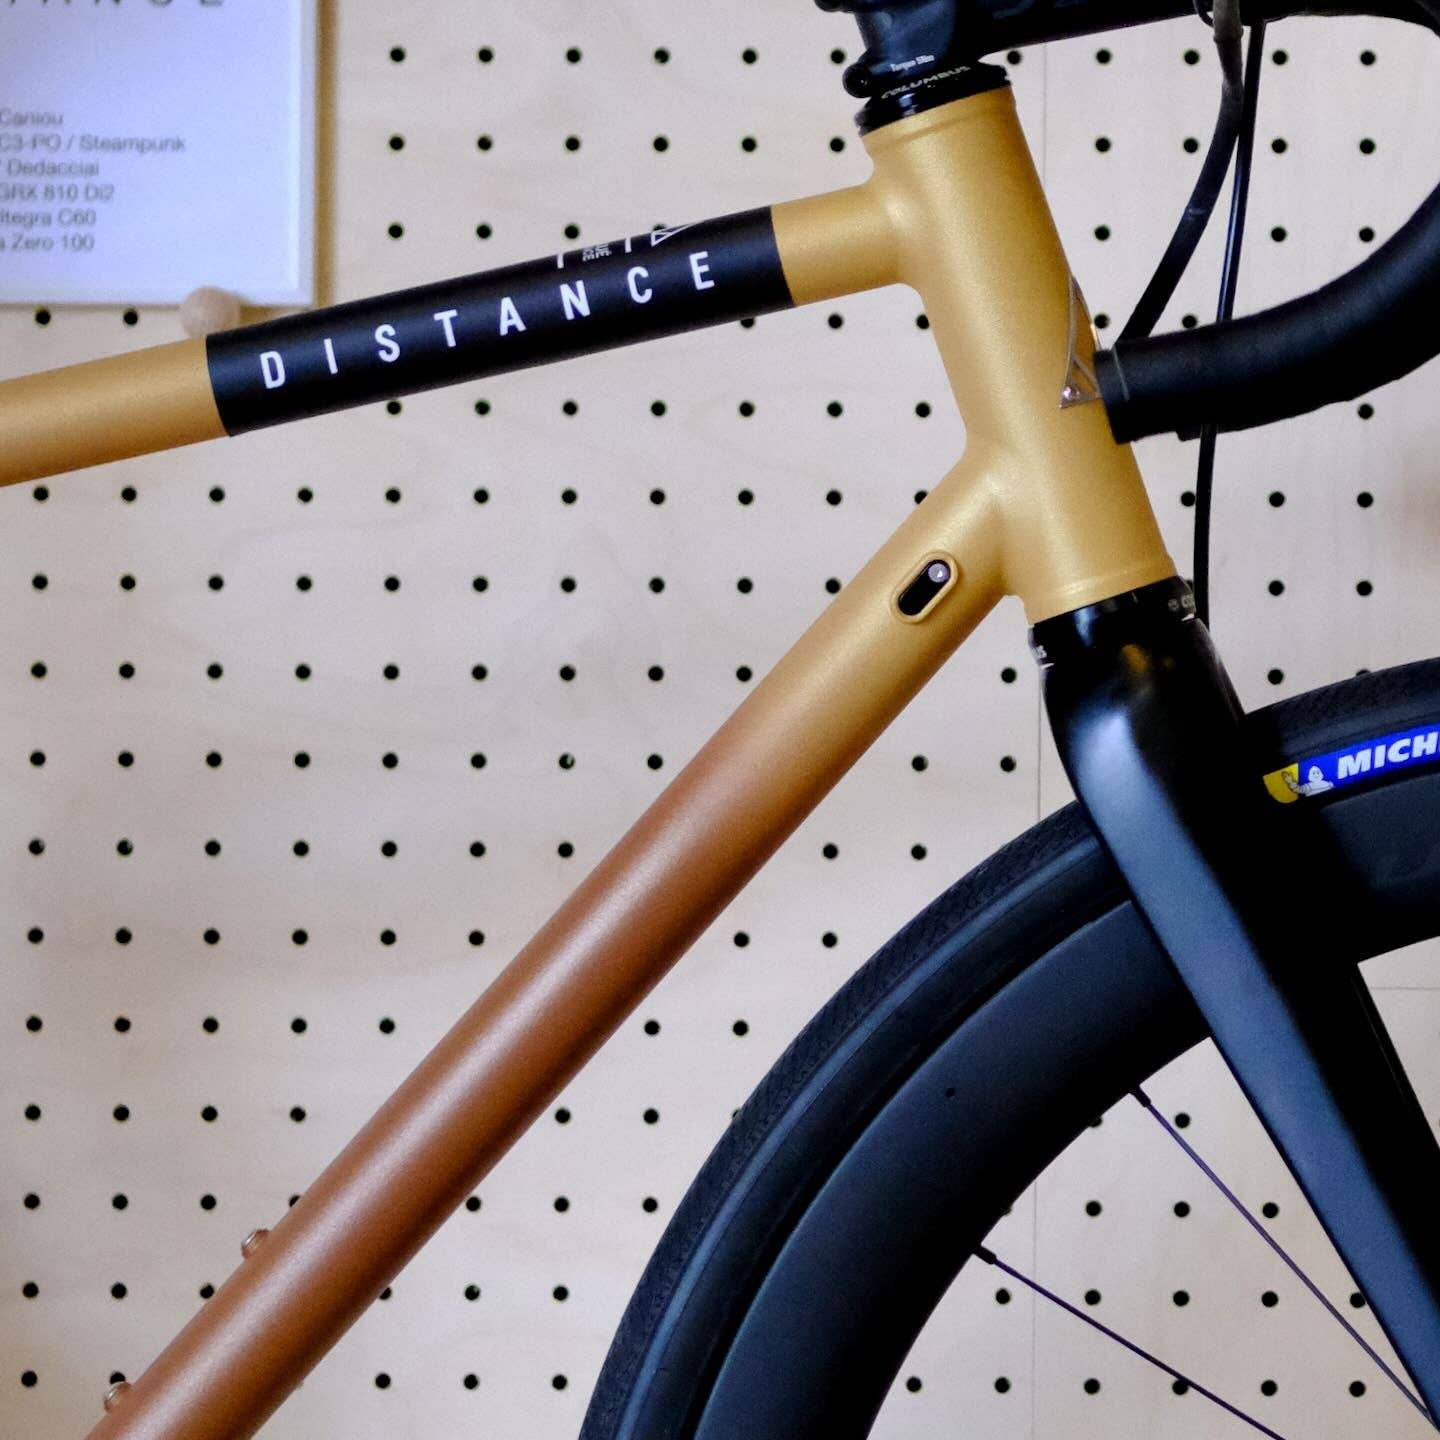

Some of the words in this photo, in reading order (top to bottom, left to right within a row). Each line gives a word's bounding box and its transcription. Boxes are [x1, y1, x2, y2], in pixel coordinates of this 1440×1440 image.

[80, 134, 187, 154] Steampunk
[61, 234, 96, 252] 100
[260, 251, 716, 390] DISTANCE
